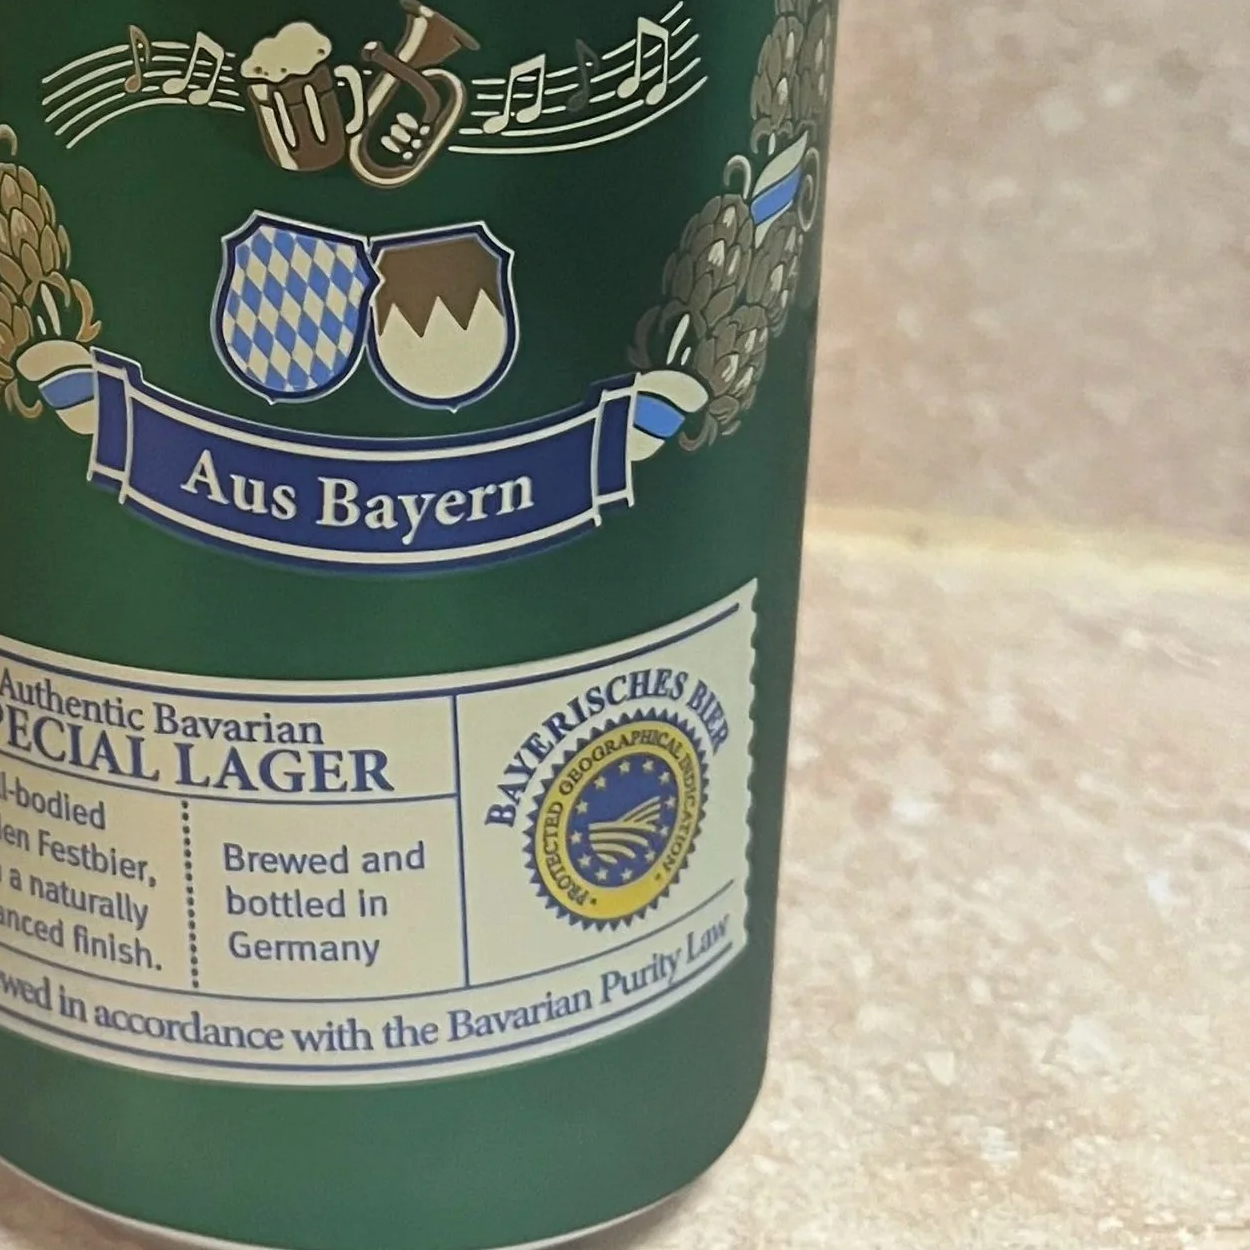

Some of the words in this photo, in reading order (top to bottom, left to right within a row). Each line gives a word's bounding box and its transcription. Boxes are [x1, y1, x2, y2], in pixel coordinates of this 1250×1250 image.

[180, 449, 297, 519] Aus
[316, 475, 534, 545] Bayern
[153, 702, 324, 746] Bavarian
[484, 667, 685, 828] BAYERISCHES
[686, 684, 730, 756] BIER
[174, 742, 395, 793] LAGER
[559, 729, 683, 795] GEOGRAPHICAL
[662, 752, 696, 872] INDICATION
[38, 829, 157, 888] Festbier,
[224, 842, 348, 875] Brewed
[361, 840, 425, 872] and
[543, 802, 589, 905] PROTECTED
[10, 866, 22, 892] a
[30, 876, 149, 930] naturally
[226, 885, 346, 918] bottled
[359, 889, 388, 916] in
[74, 925, 162, 972] finish.
[229, 931, 380, 967] Germany
[59, 985, 86, 1023] in
[95, 1004, 284, 1050] accordance
[291, 1019, 371, 1053] with
[382, 1015, 438, 1048] the
[447, 990, 592, 1042] Bavarian
[600, 947, 681, 1003] Purity
[686, 912, 730, 962] Law
